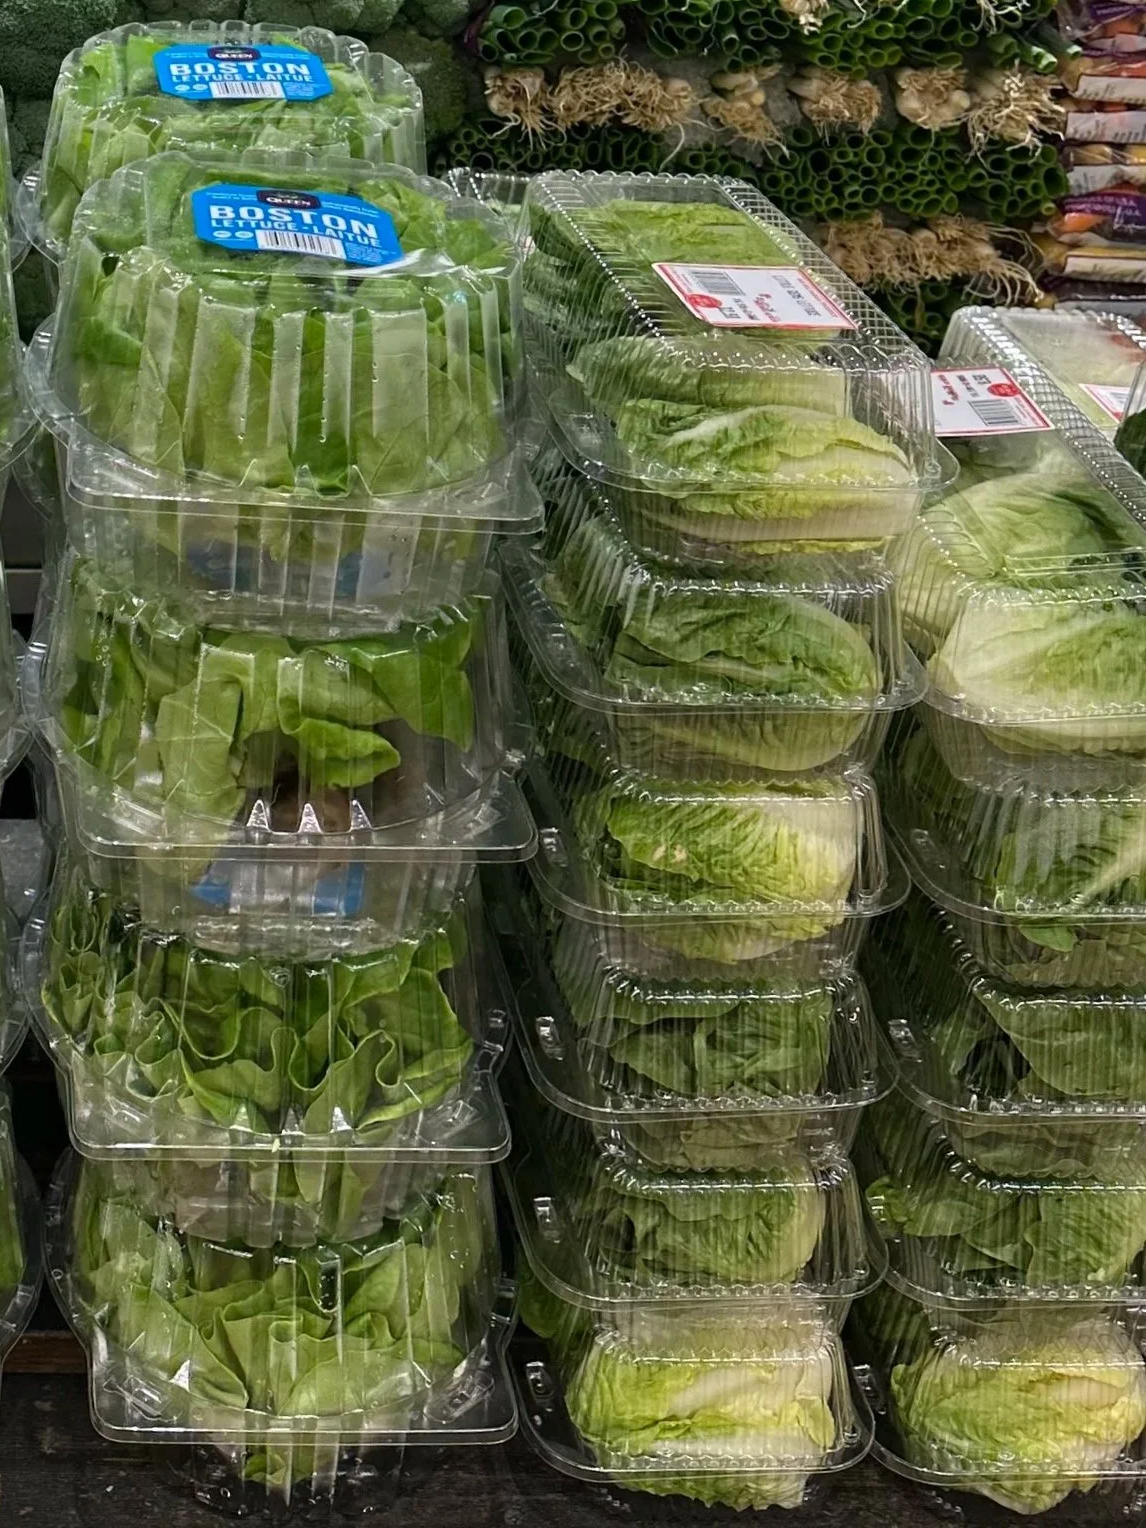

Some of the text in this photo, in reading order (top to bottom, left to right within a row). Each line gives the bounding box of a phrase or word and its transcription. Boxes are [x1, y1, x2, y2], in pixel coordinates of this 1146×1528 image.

[169, 62, 311, 76] BOSTON
[171, 74, 314, 83] LETTUCE LAITUE
[266, 196, 312, 207] QUEEN
[209, 204, 379, 239] BOSTON
[211, 219, 383, 249] LETTUCE LAITUE
